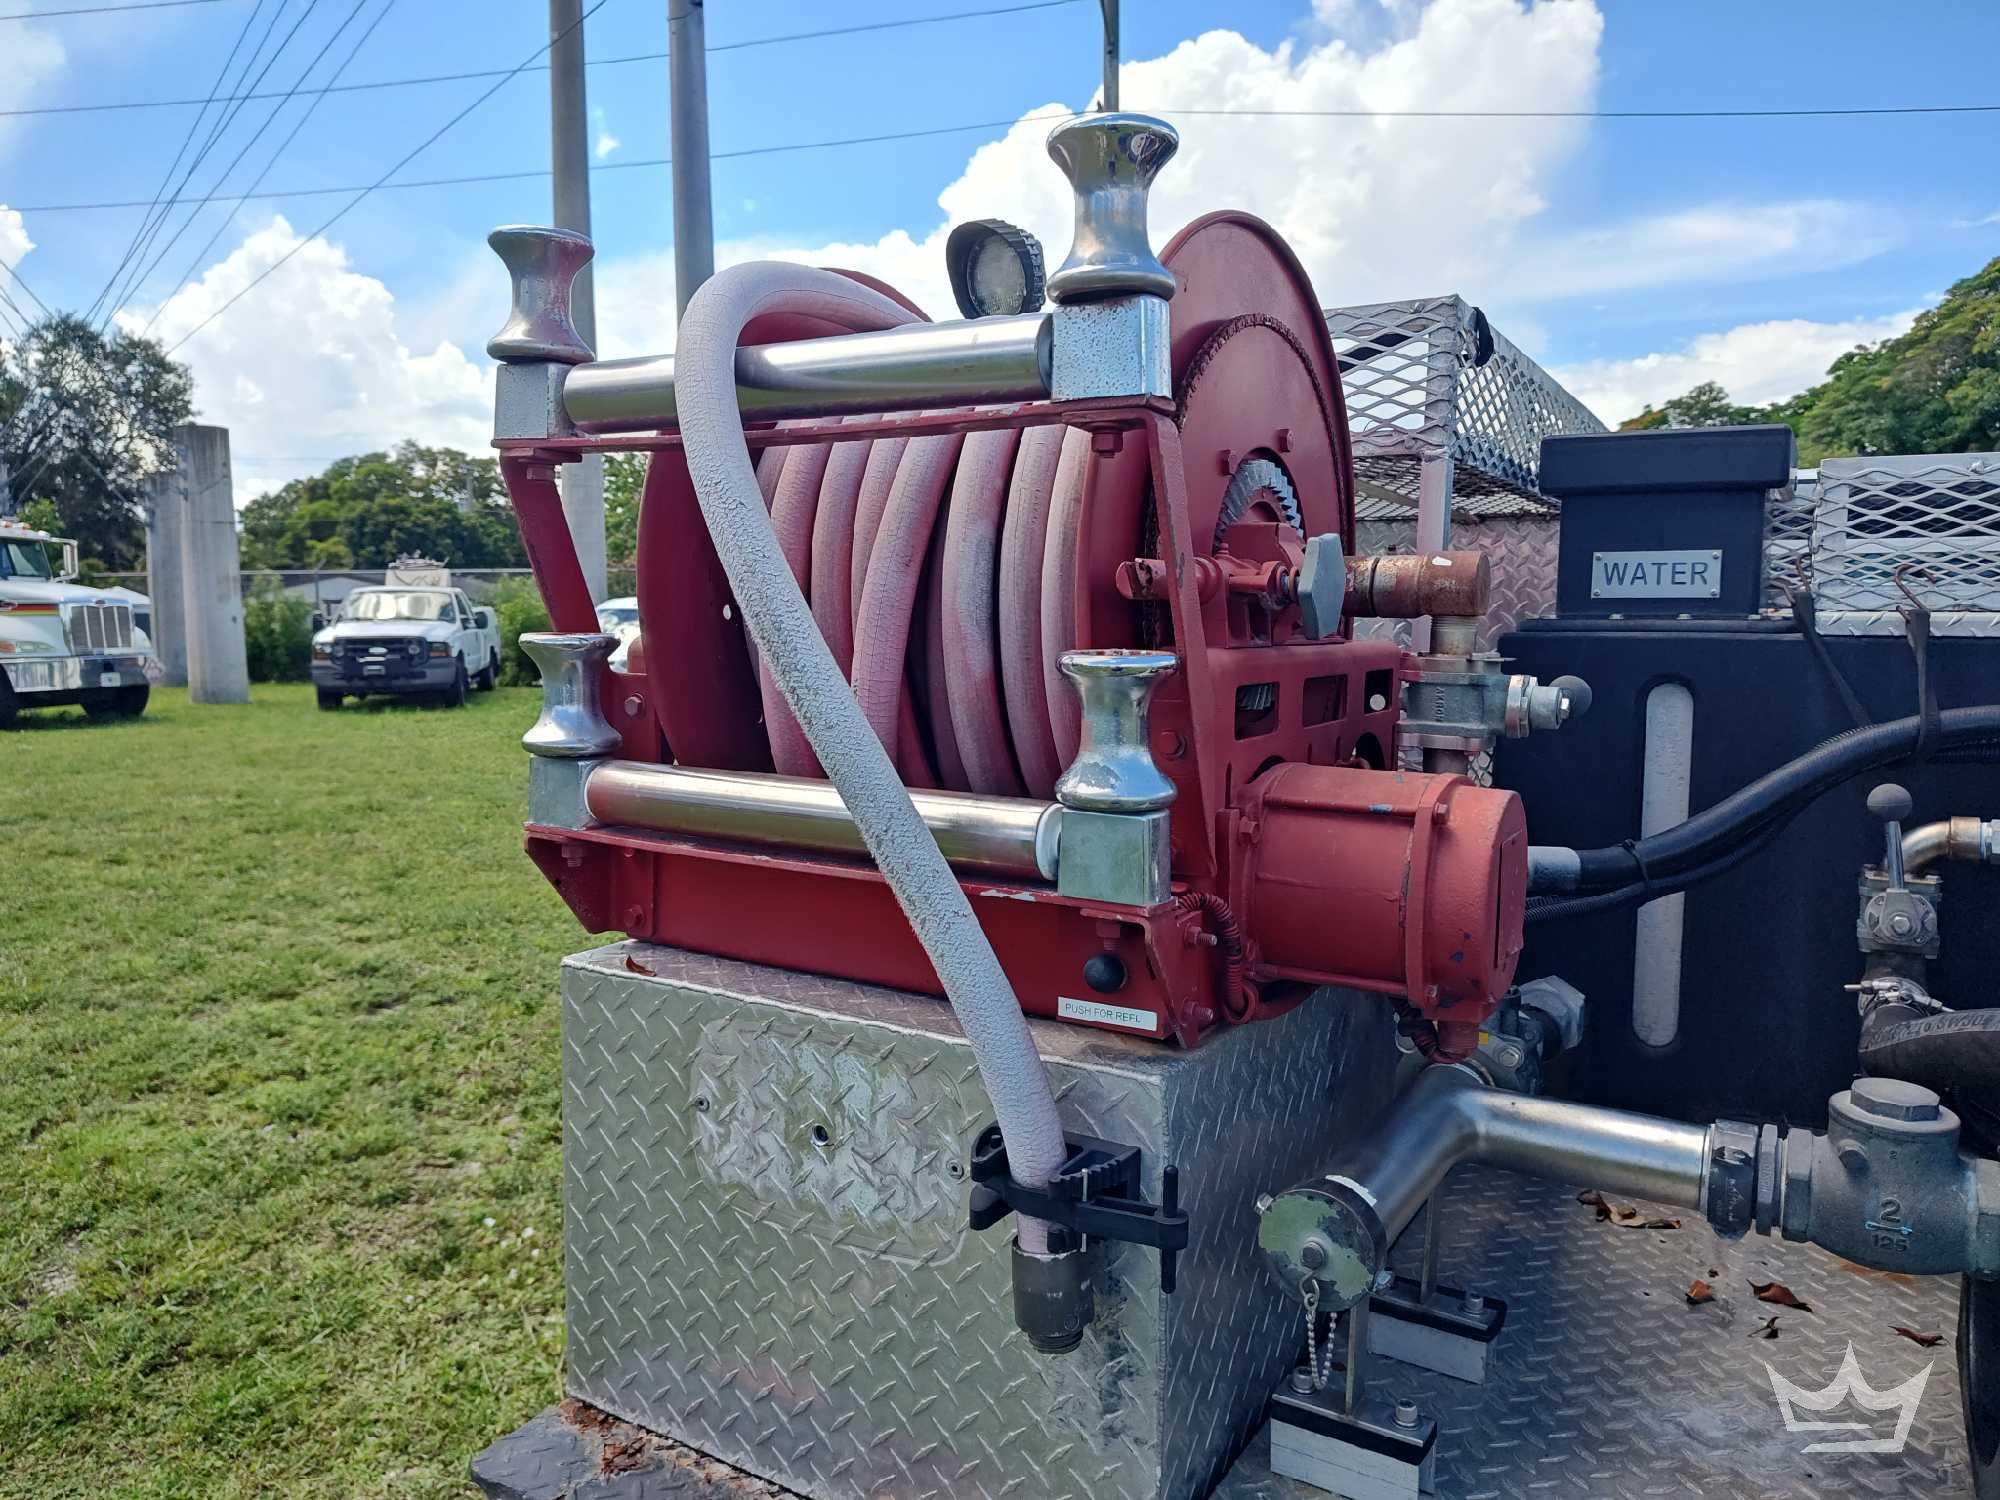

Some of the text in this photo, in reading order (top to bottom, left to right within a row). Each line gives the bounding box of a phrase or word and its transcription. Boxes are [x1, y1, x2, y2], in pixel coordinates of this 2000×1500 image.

[1604, 562, 1708, 586] WATER
[1065, 1003, 1091, 1017] PUSH
[1094, 1008, 1112, 1019] FOR
[1880, 1197, 1901, 1223] 2
[1872, 1234, 1908, 1252] 125
